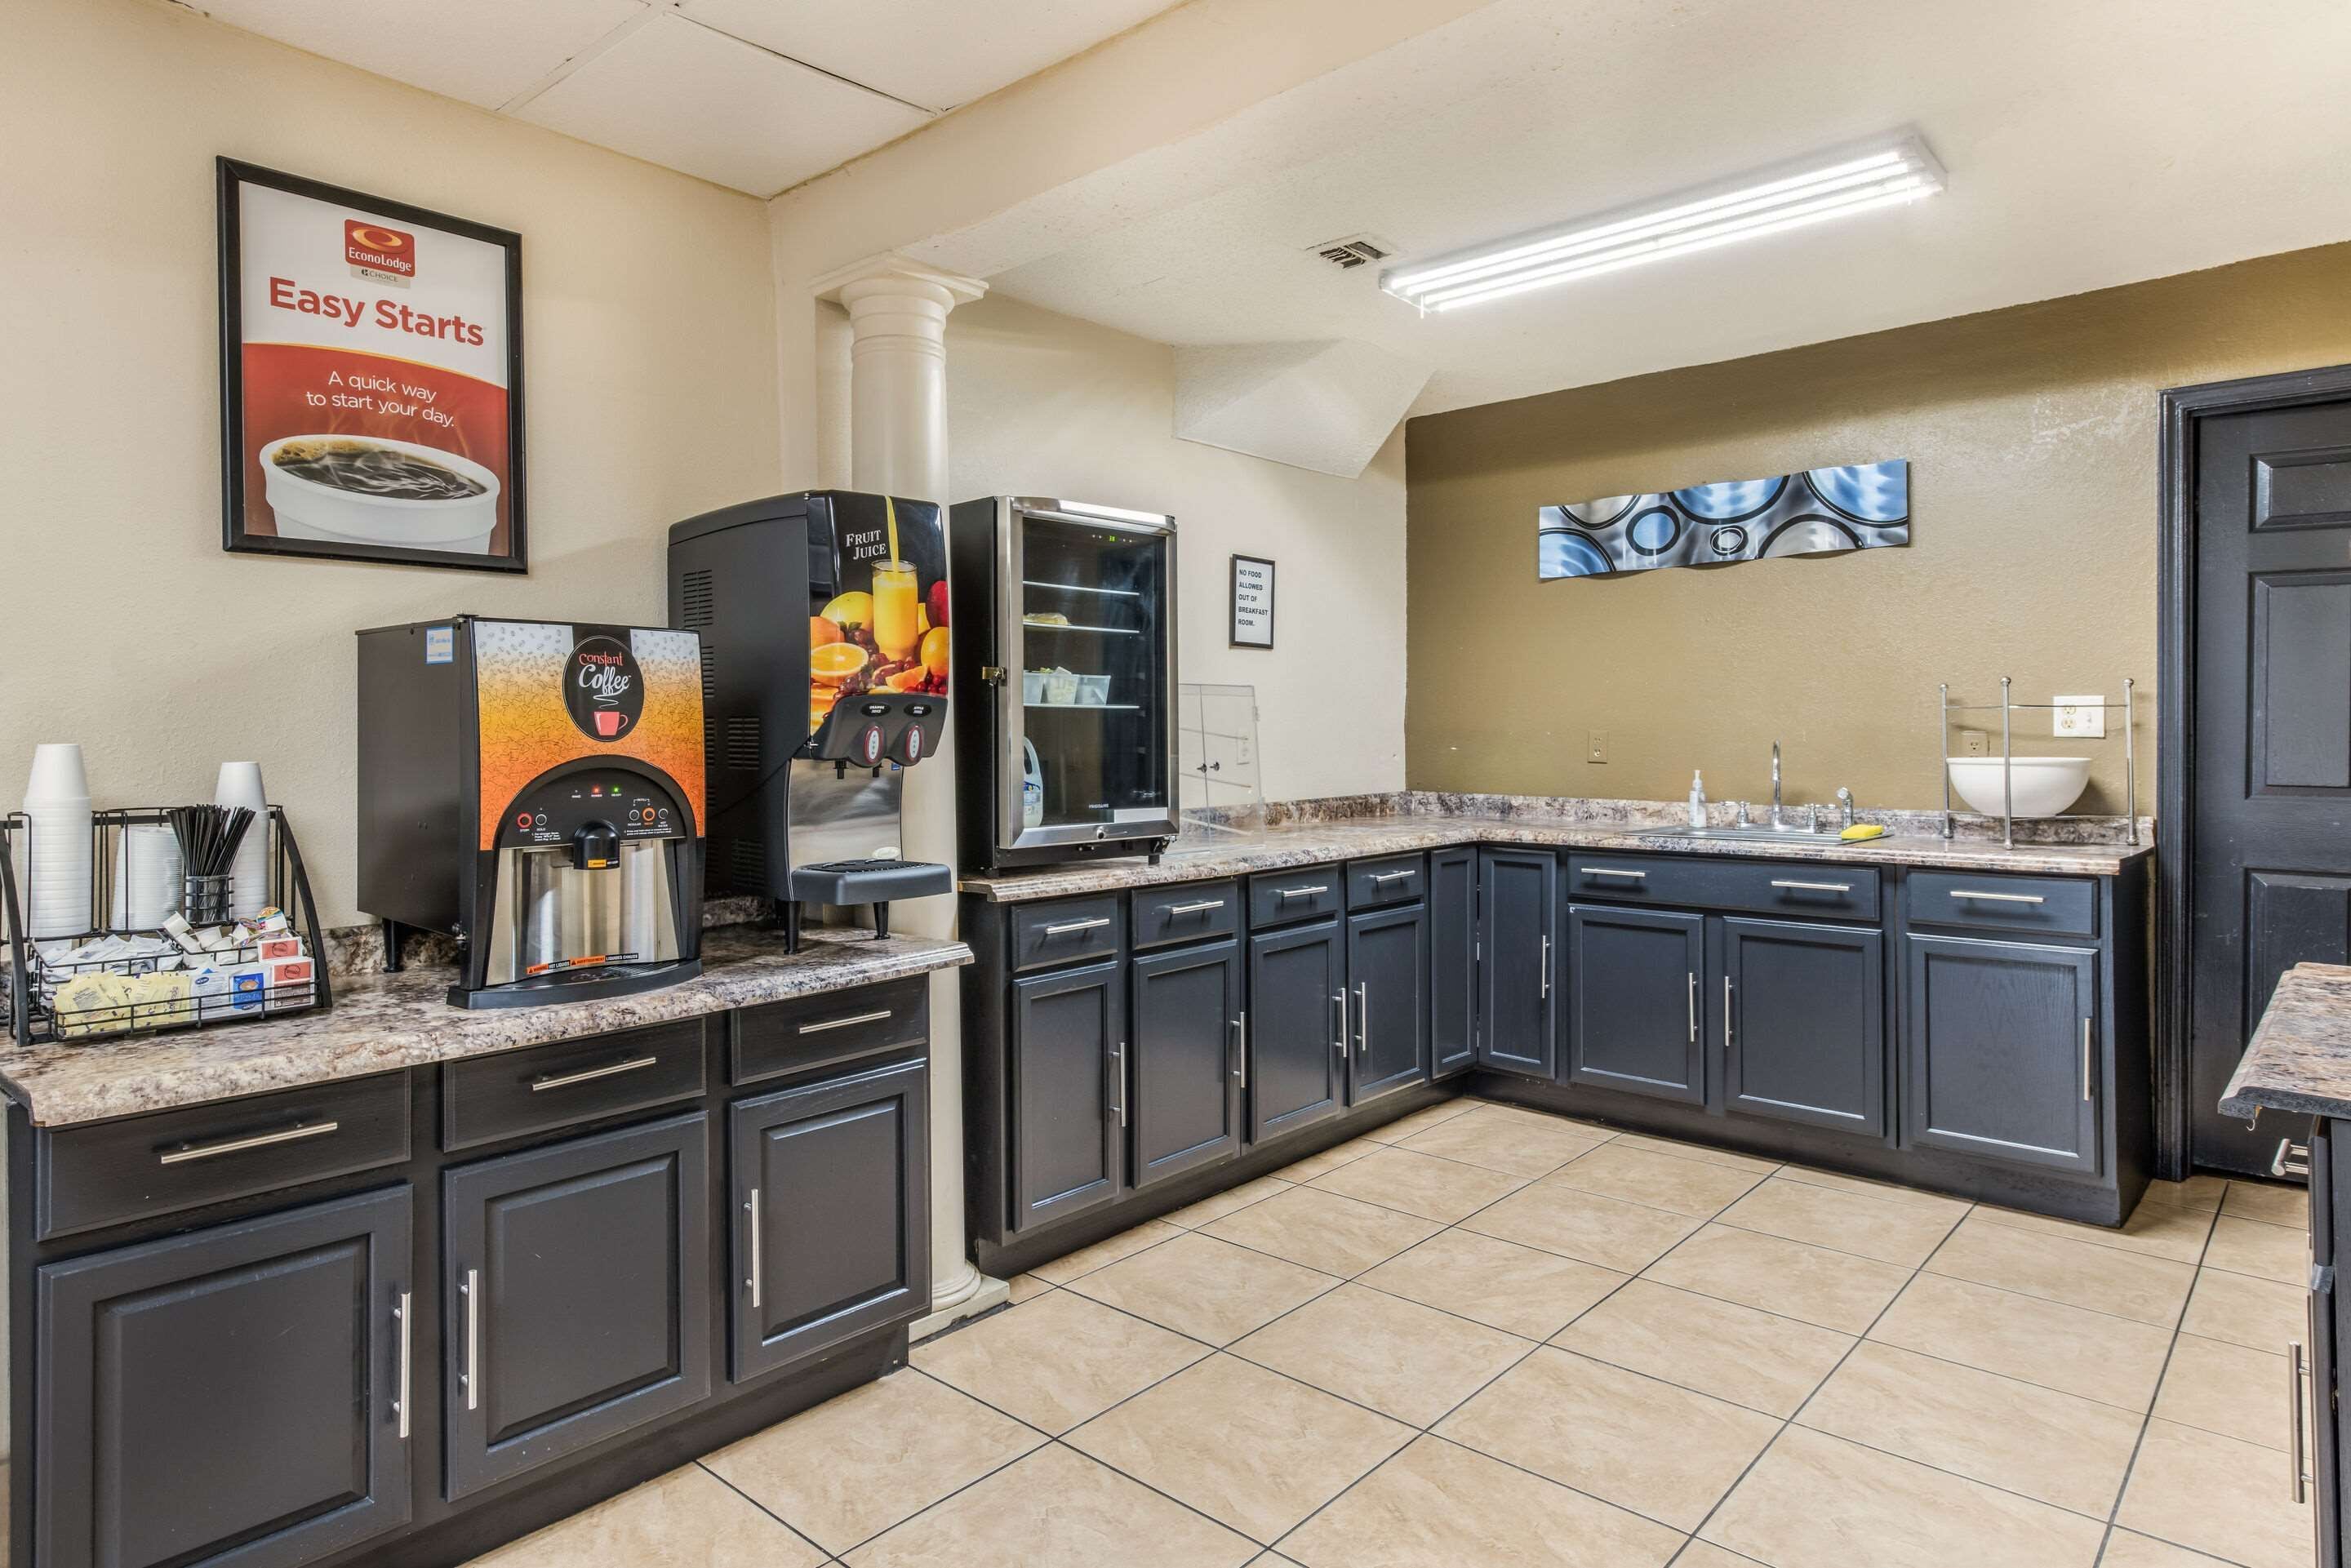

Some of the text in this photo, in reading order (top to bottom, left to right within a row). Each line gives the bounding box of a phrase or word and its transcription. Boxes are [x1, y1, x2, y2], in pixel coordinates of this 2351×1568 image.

[349, 247, 412, 273] EconoLodge
[269, 276, 484, 346] Easy Starts
[328, 371, 437, 403] A quick way
[306, 391, 455, 428] to start your day.
[845, 530, 882, 547] FRUIT
[852, 543, 887, 560] JUICE
[1248, 571, 1262, 579] FOOD
[1238, 582, 1263, 591] ALLOWED
[1238, 606, 1269, 616] BREAKFAST
[1238, 619, 1255, 627] ROOM.
[579, 651, 624, 667] Constant
[578, 664, 630, 695] Coffee
